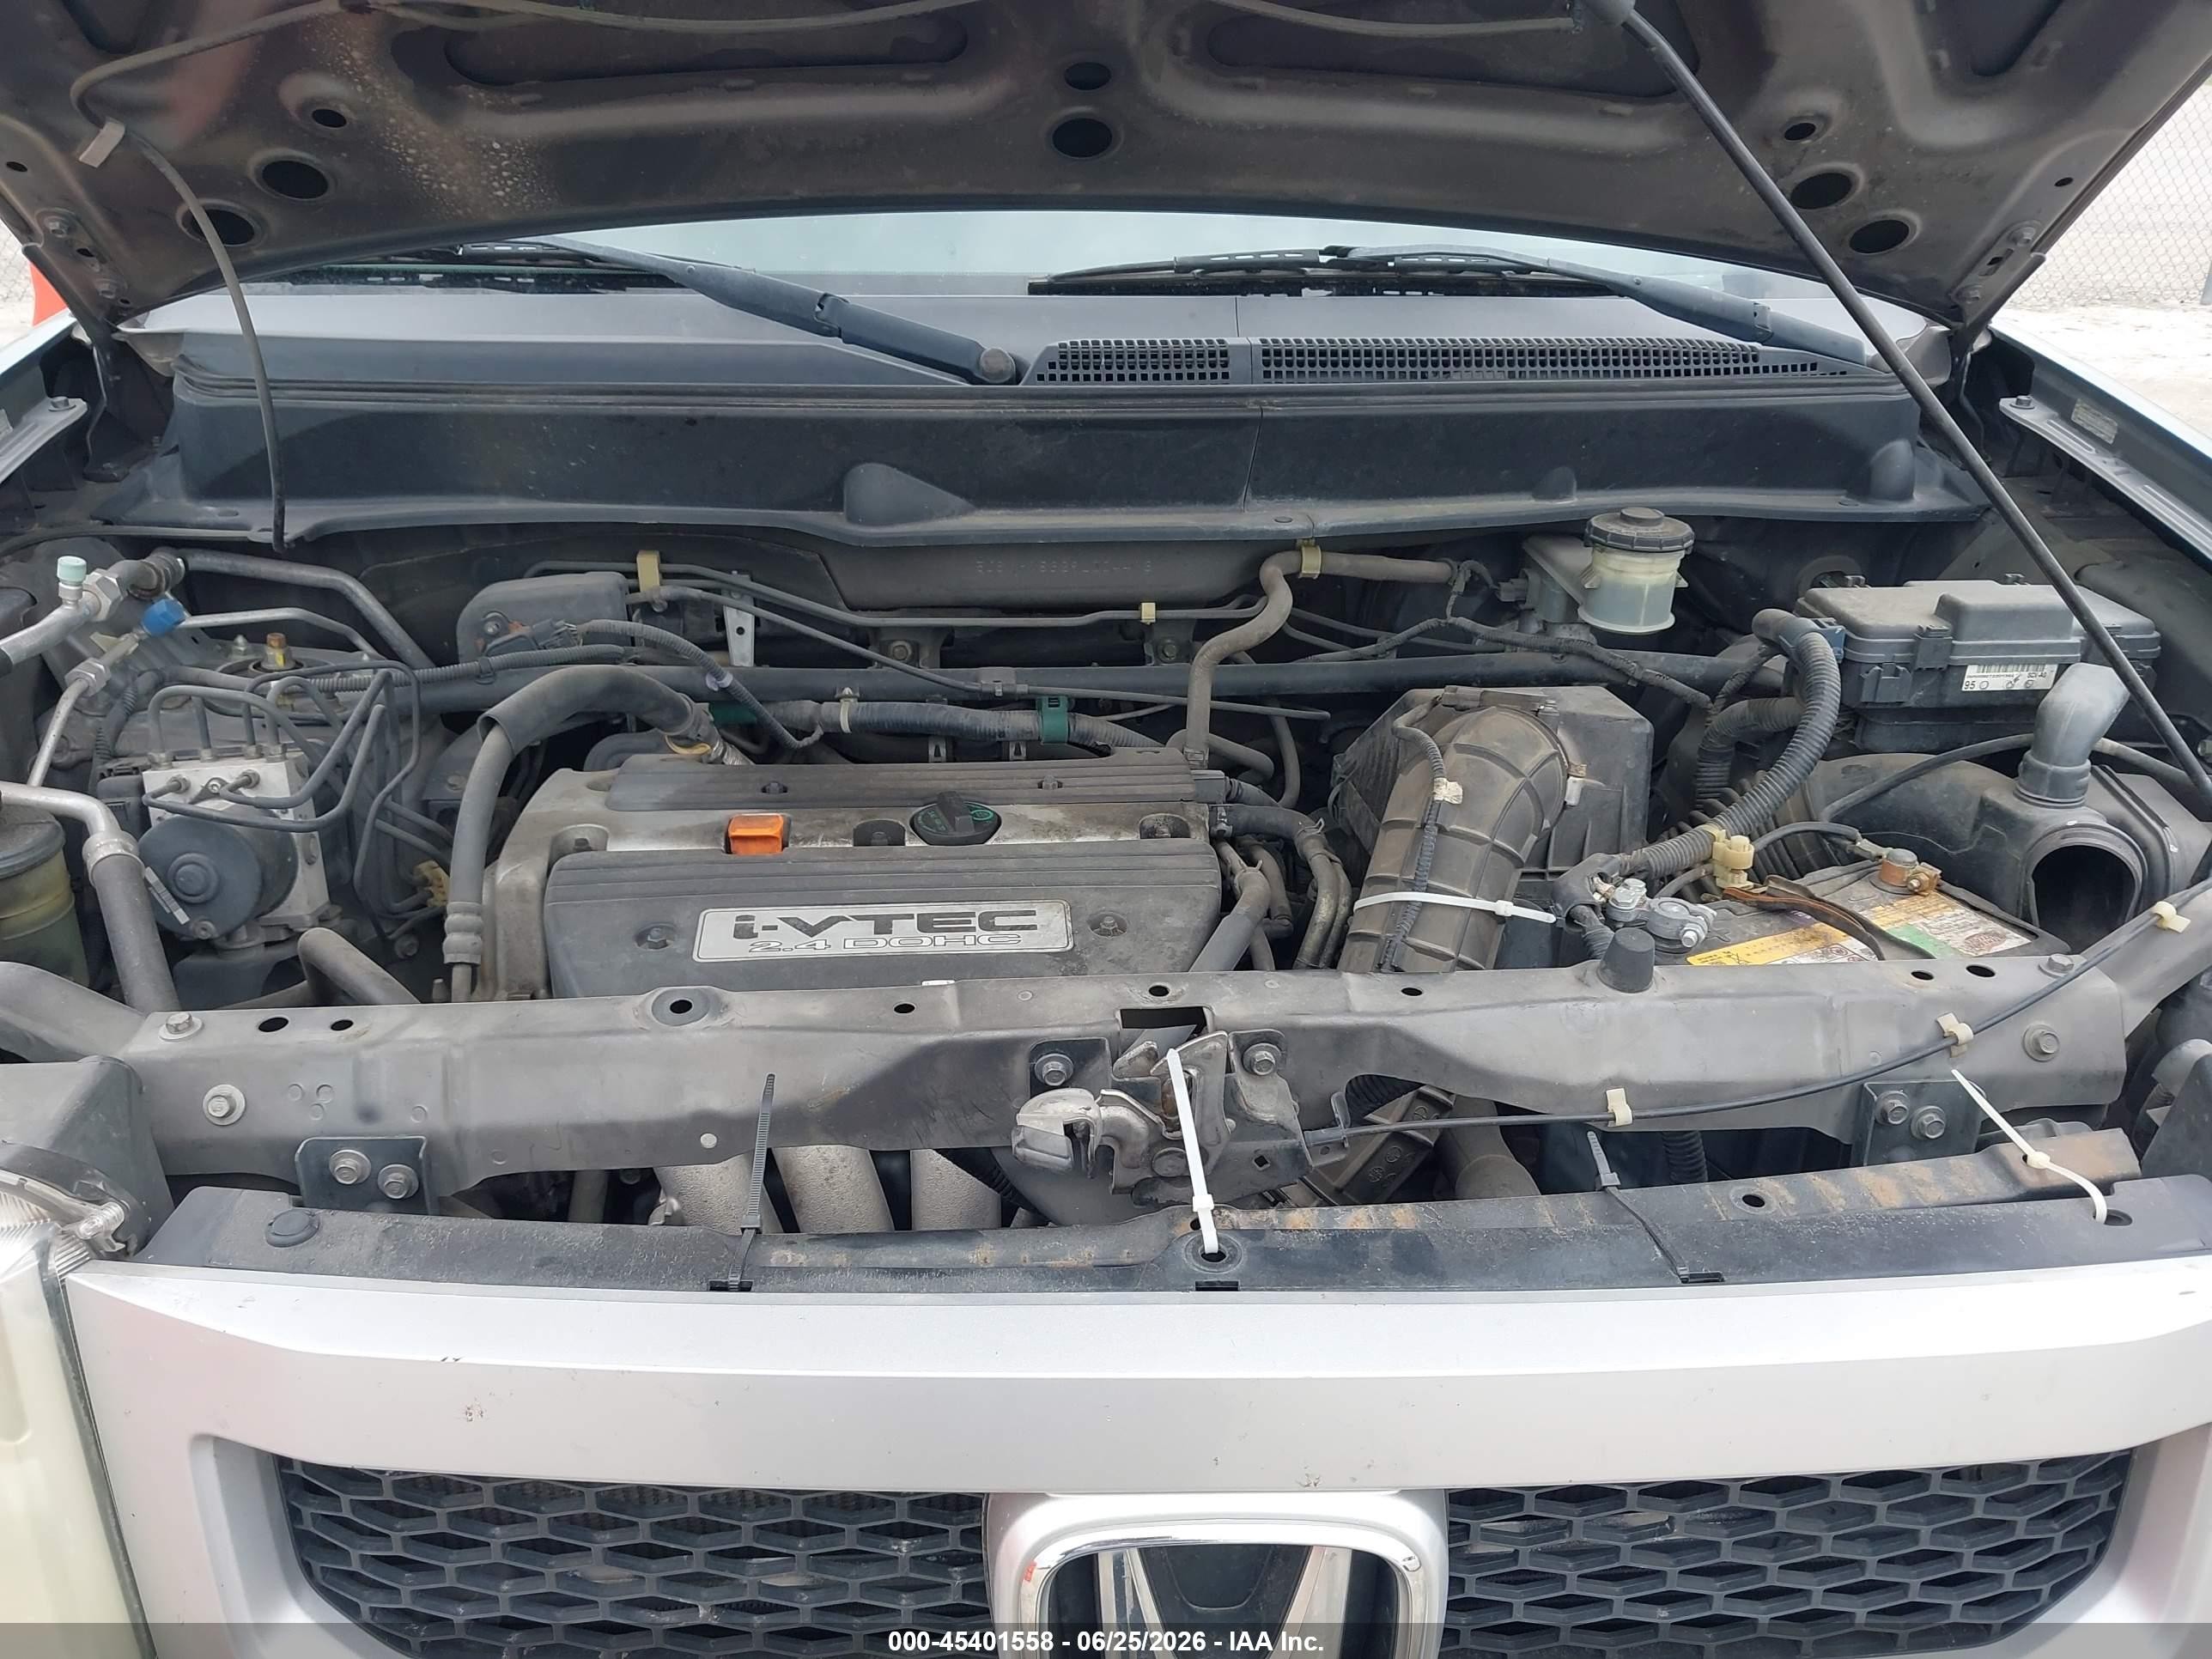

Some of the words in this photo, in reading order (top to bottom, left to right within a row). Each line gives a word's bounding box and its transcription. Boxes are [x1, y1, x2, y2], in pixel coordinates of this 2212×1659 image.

[732, 909, 1038, 939] i-VTEC
[748, 939, 832, 953] 2.4
[842, 933, 1023, 950] DOHC
